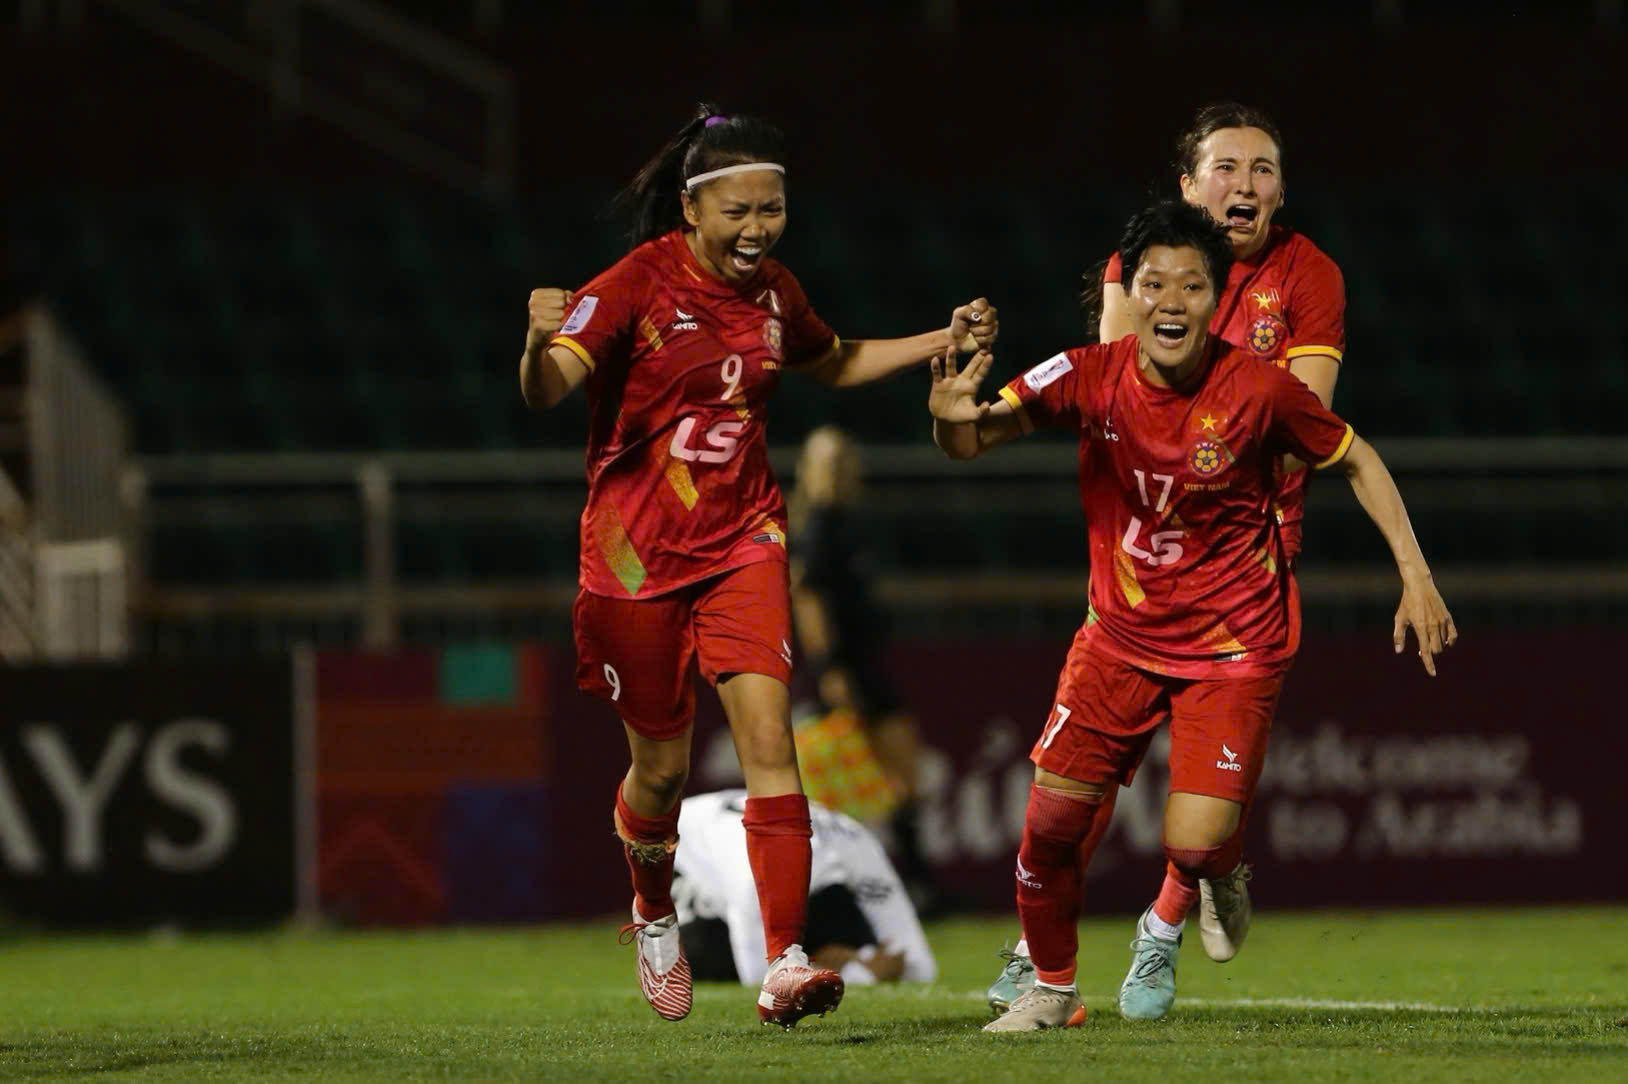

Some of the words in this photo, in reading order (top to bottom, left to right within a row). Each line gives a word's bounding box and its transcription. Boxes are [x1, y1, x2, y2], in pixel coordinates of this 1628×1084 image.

[721, 354, 743, 401] 9
[670, 417, 743, 463] LS
[1133, 469, 1174, 512] 17
[1122, 516, 1184, 566] LS
[603, 663, 621, 701] 9
[1216, 760, 1242, 772] KAMITO
